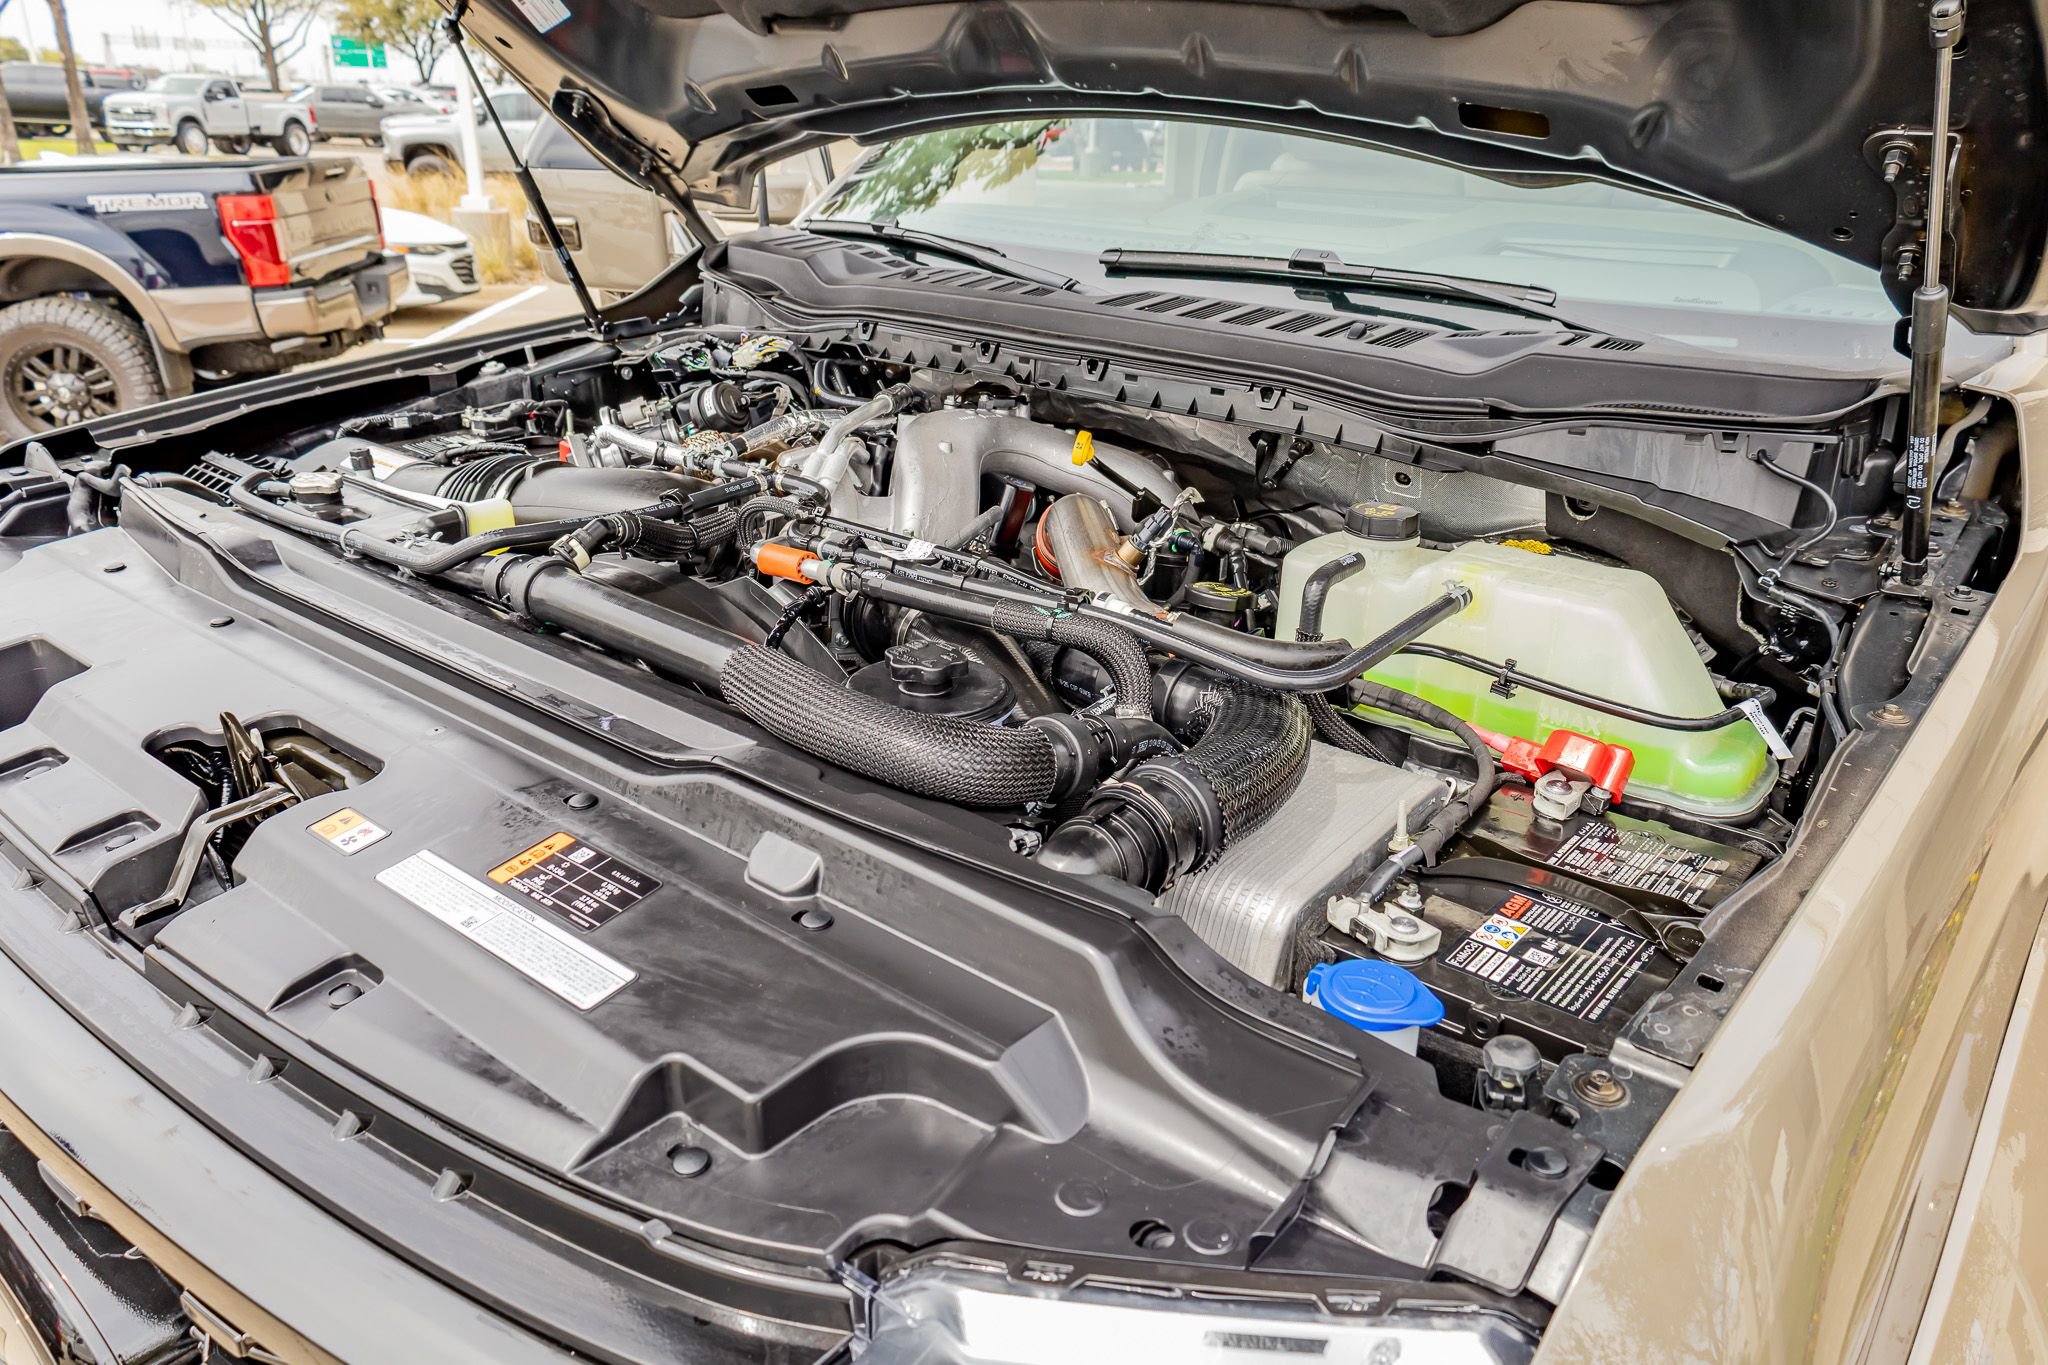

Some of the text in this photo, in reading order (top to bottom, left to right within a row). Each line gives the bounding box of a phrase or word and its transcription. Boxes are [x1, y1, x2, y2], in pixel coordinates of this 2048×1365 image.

[87, 192, 208, 213] TREMOR
[1906, 495, 1920, 509] (L)
[1500, 895, 1528, 917] AGM
[1451, 941, 1479, 966] FoMoCo
